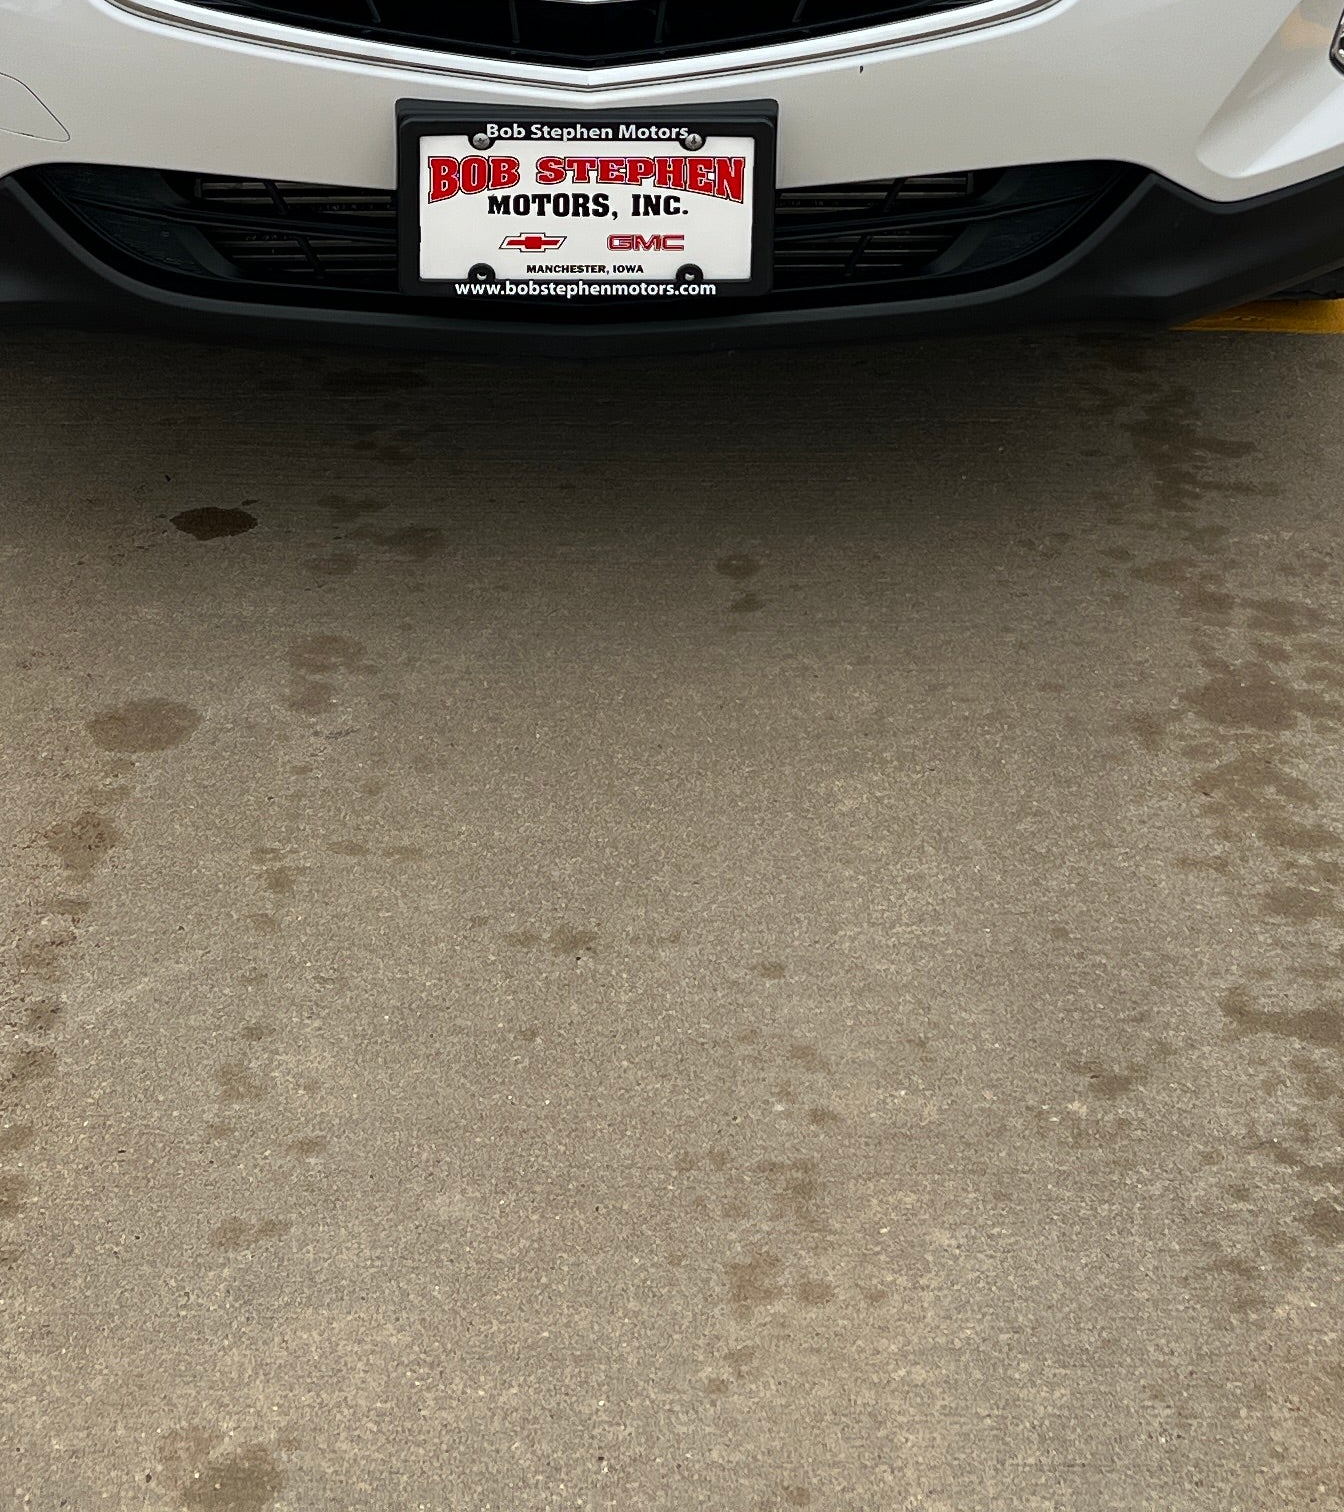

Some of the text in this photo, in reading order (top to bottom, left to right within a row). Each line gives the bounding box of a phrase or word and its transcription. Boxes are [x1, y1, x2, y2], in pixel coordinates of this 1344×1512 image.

[486, 123, 689, 142] Bob Stephen Motors
[427, 155, 747, 205] BOB STEPHEN
[487, 192, 689, 220] MOTORS, INC.
[606, 233, 685, 252] GMC
[526, 264, 645, 275] MANCHESTER, IOWA
[455, 280, 717, 299] www.bobstephenmotors.com
